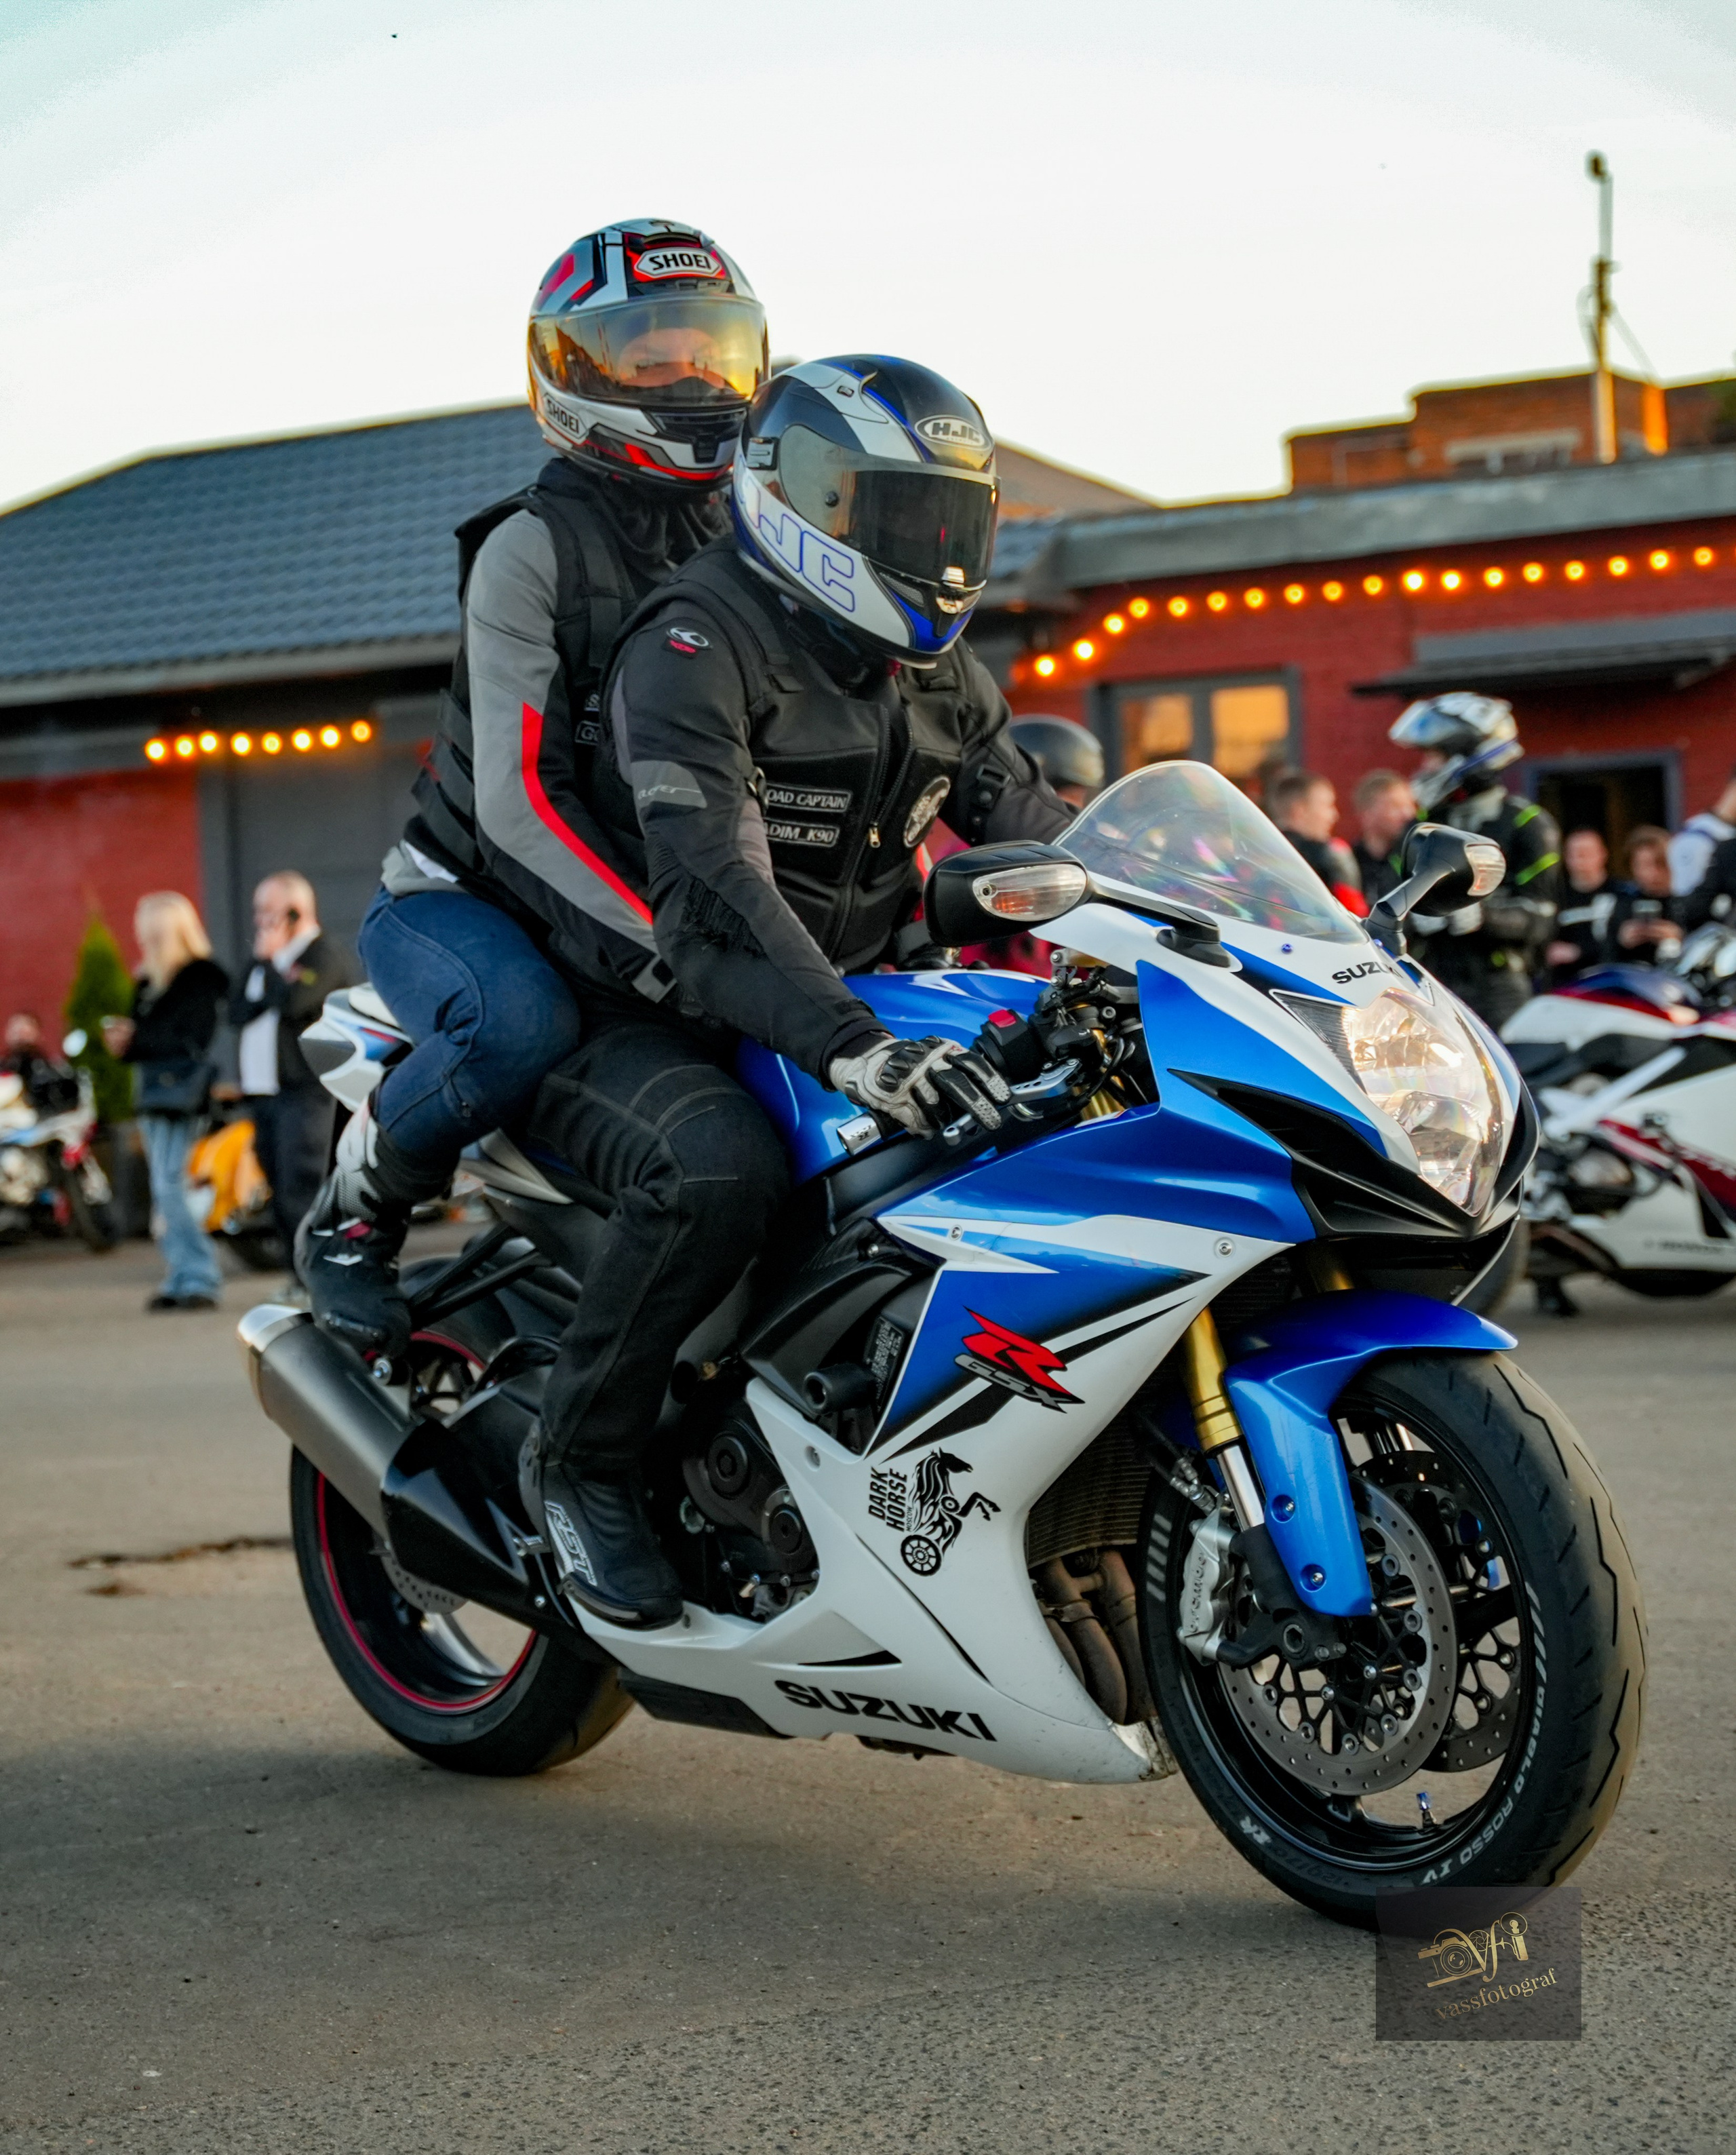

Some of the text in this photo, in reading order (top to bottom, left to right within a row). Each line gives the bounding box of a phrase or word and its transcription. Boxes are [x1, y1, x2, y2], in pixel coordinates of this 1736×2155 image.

[648, 252, 711, 271] SHOEI
[547, 400, 579, 433] SHOEI
[931, 422, 981, 443] HJC
[767, 789, 847, 809] OAD CAPTAIN
[868, 1466, 889, 1521] DARK
[886, 1468, 908, 1532] HORSE
[544, 1499, 597, 1587] RST
[774, 1680, 998, 1742] SUZUKI
[1421, 1686, 1545, 1885] DIABLO ROSSO IV
